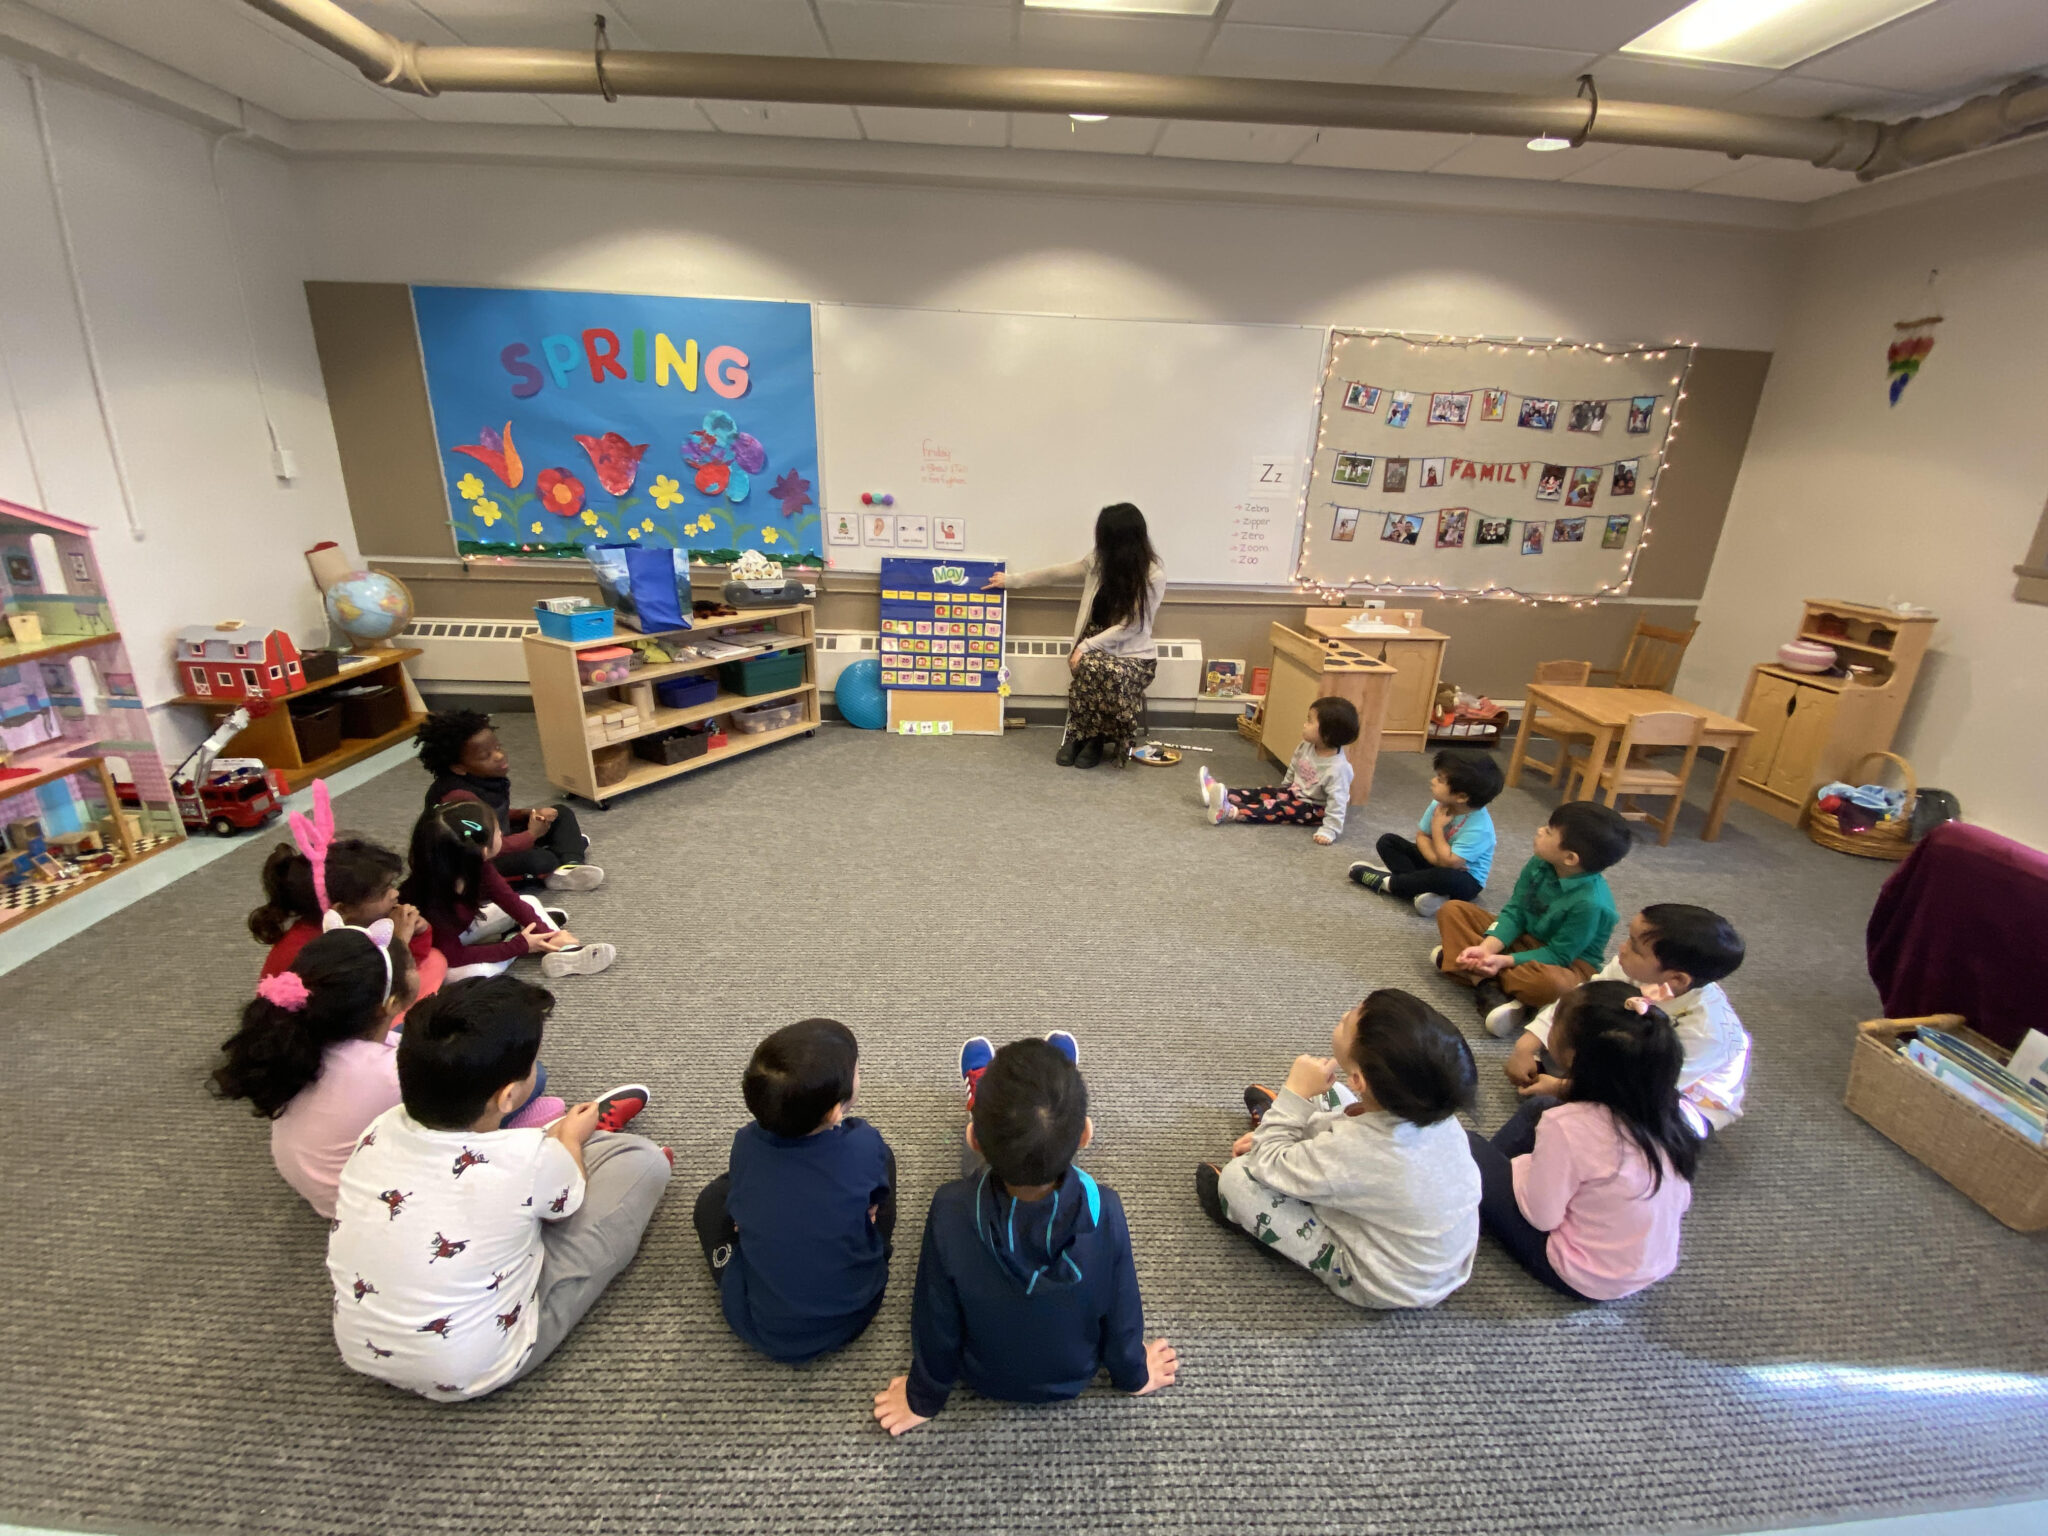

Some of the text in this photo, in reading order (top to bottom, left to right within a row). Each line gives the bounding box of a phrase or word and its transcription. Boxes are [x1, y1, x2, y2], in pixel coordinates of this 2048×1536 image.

[501, 327, 751, 399] SPRING
[1260, 463, 1283, 483] Zz
[1450, 458, 1531, 483] FAMILY
[1244, 503, 1270, 513] Zebra
[1243, 518, 1271, 530] Zipper
[1240, 531, 1265, 541] Zero
[1239, 543, 1270, 553] Zoom
[1238, 555, 1259, 565] Zoo
[934, 567, 964, 583] May
